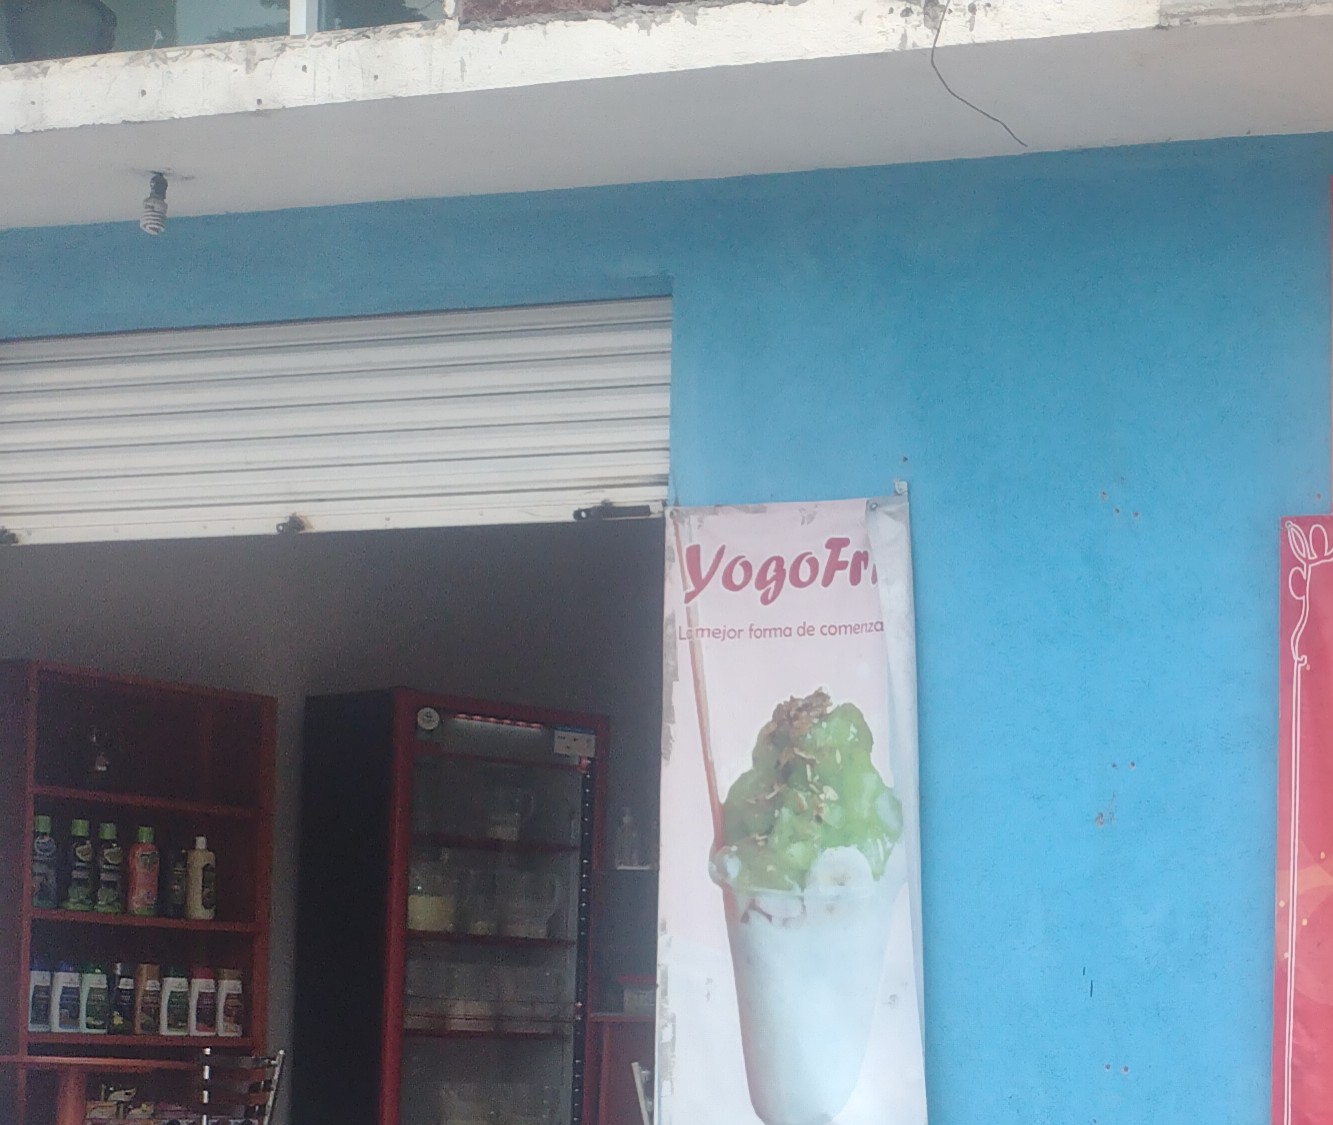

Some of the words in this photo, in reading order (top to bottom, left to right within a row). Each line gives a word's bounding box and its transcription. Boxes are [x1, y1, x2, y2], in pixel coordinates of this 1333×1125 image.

[695, 625, 744, 641] mejor
[748, 623, 793, 639] forma
[796, 621, 816, 636] de
